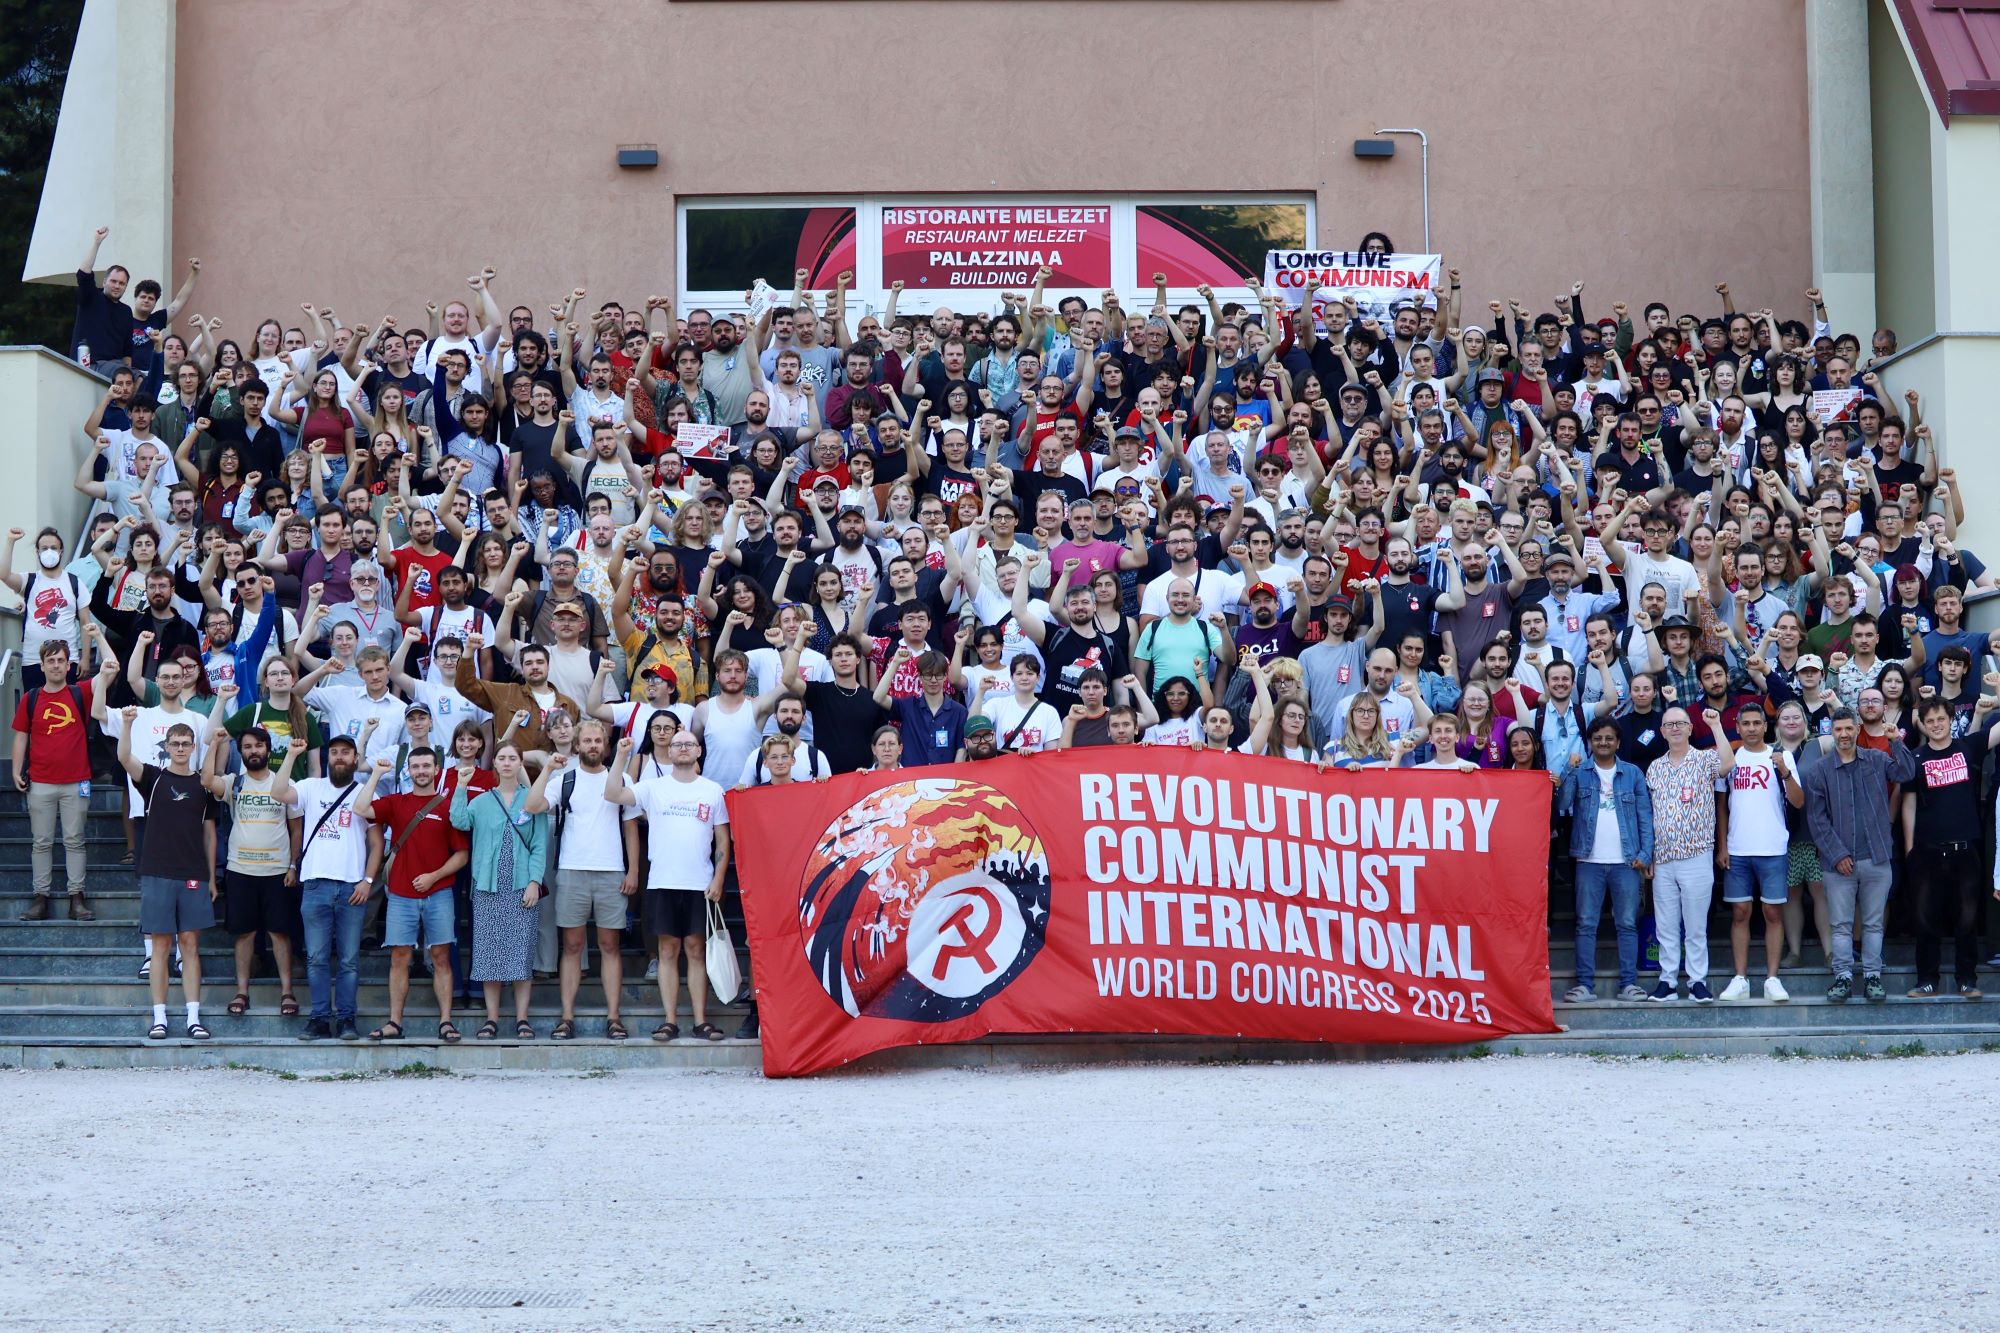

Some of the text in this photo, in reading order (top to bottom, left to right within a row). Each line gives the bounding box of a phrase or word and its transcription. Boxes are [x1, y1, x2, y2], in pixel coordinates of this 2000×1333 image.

[883, 208, 1108, 225] RISTORANTE MELEZET
[904, 229, 1087, 244] RESTAURANT MELEZET
[929, 250, 1063, 266] PALAZZINA A
[1274, 252, 1392, 270] LONG LIVE
[950, 271, 1027, 285] BUILDING
[1275, 268, 1430, 290] COMMUNISM
[1924, 752, 1967, 774] SOCIALIST
[1079, 773, 1500, 853] REVOLUTIONARY
[1083, 826, 1426, 915] COMMUNIST
[1087, 890, 1485, 981] INTERNATIONAL
[1091, 956, 1492, 1025] WORLD CONGRESS 2025
